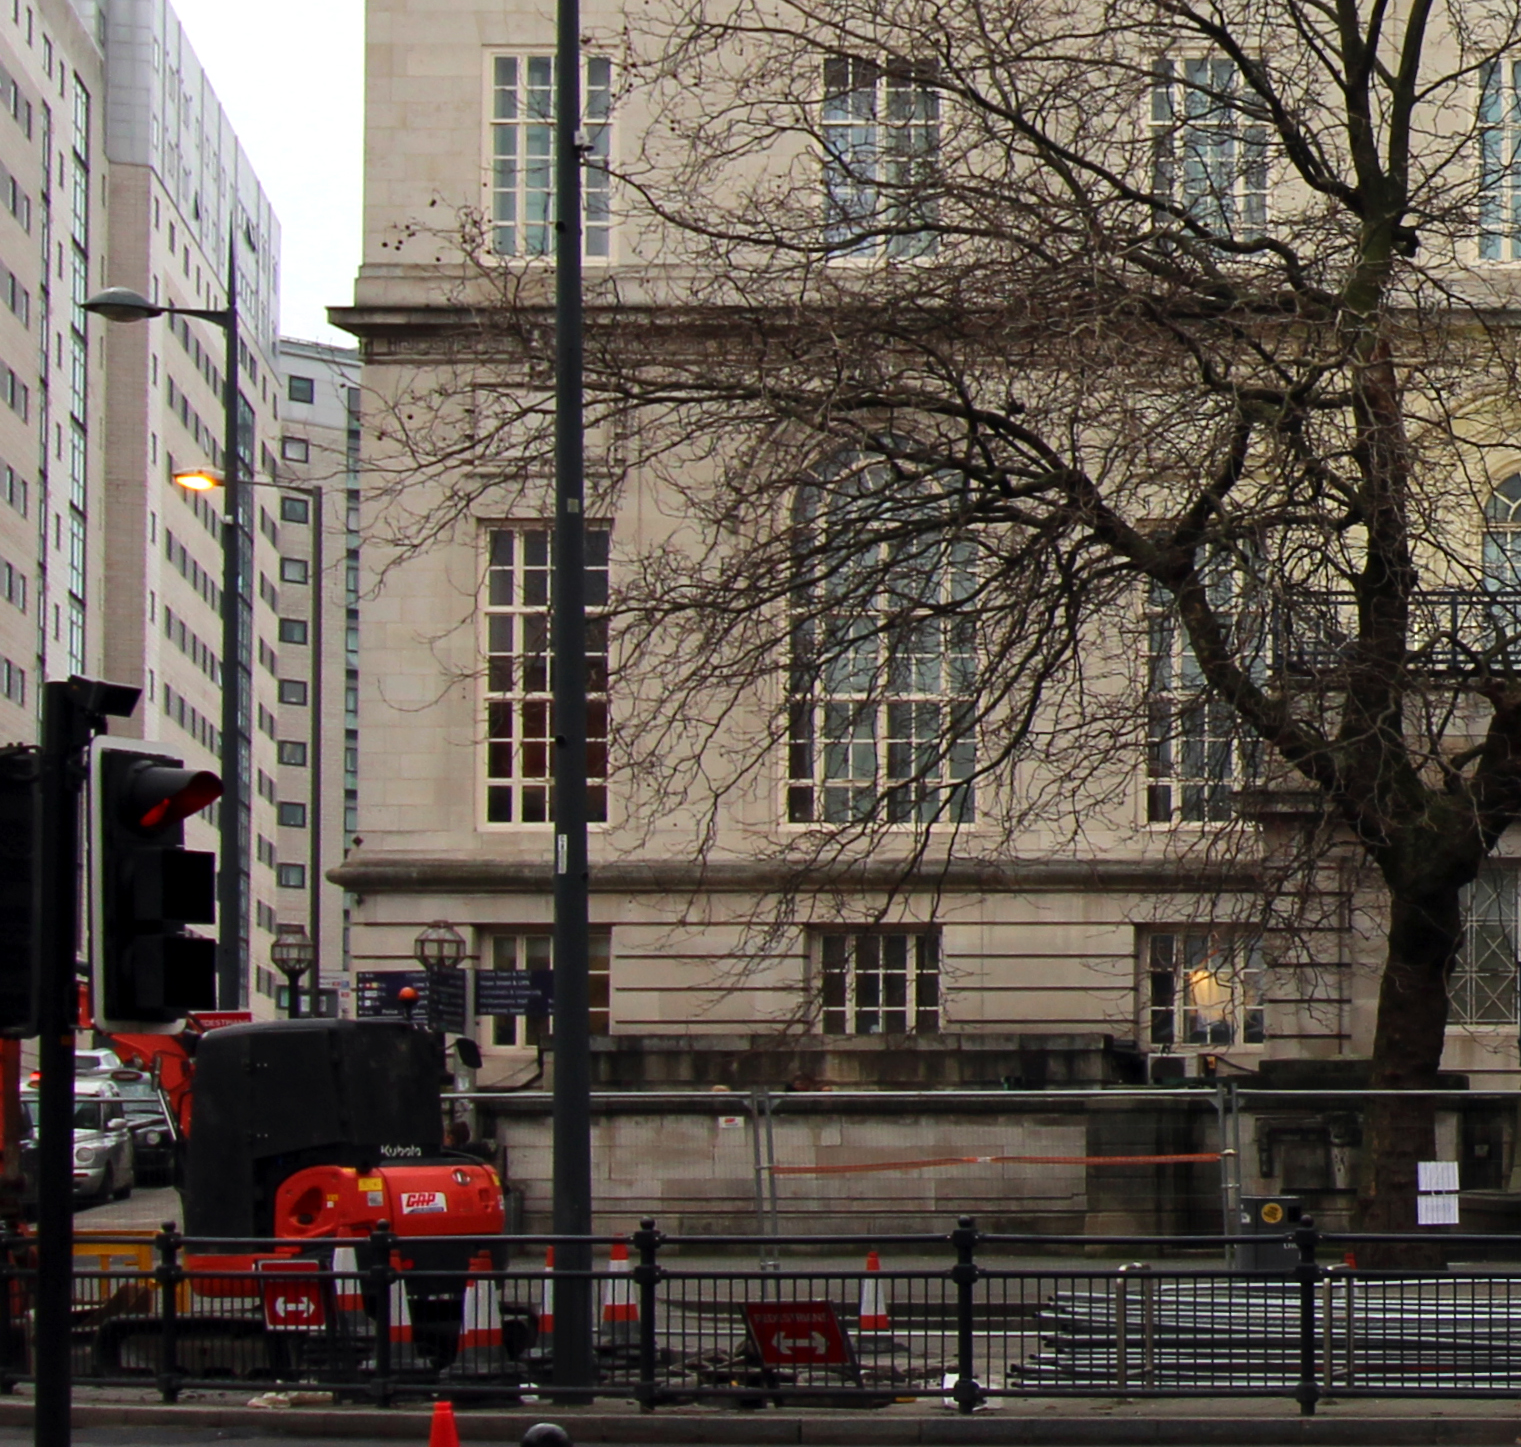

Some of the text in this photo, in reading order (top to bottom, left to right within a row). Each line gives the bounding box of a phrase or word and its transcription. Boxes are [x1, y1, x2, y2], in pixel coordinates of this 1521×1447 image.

[381, 1144, 421, 1157] Kubota
[406, 1193, 436, 1207] GAP
[753, 1313, 830, 1323] PEDESTRIANS
